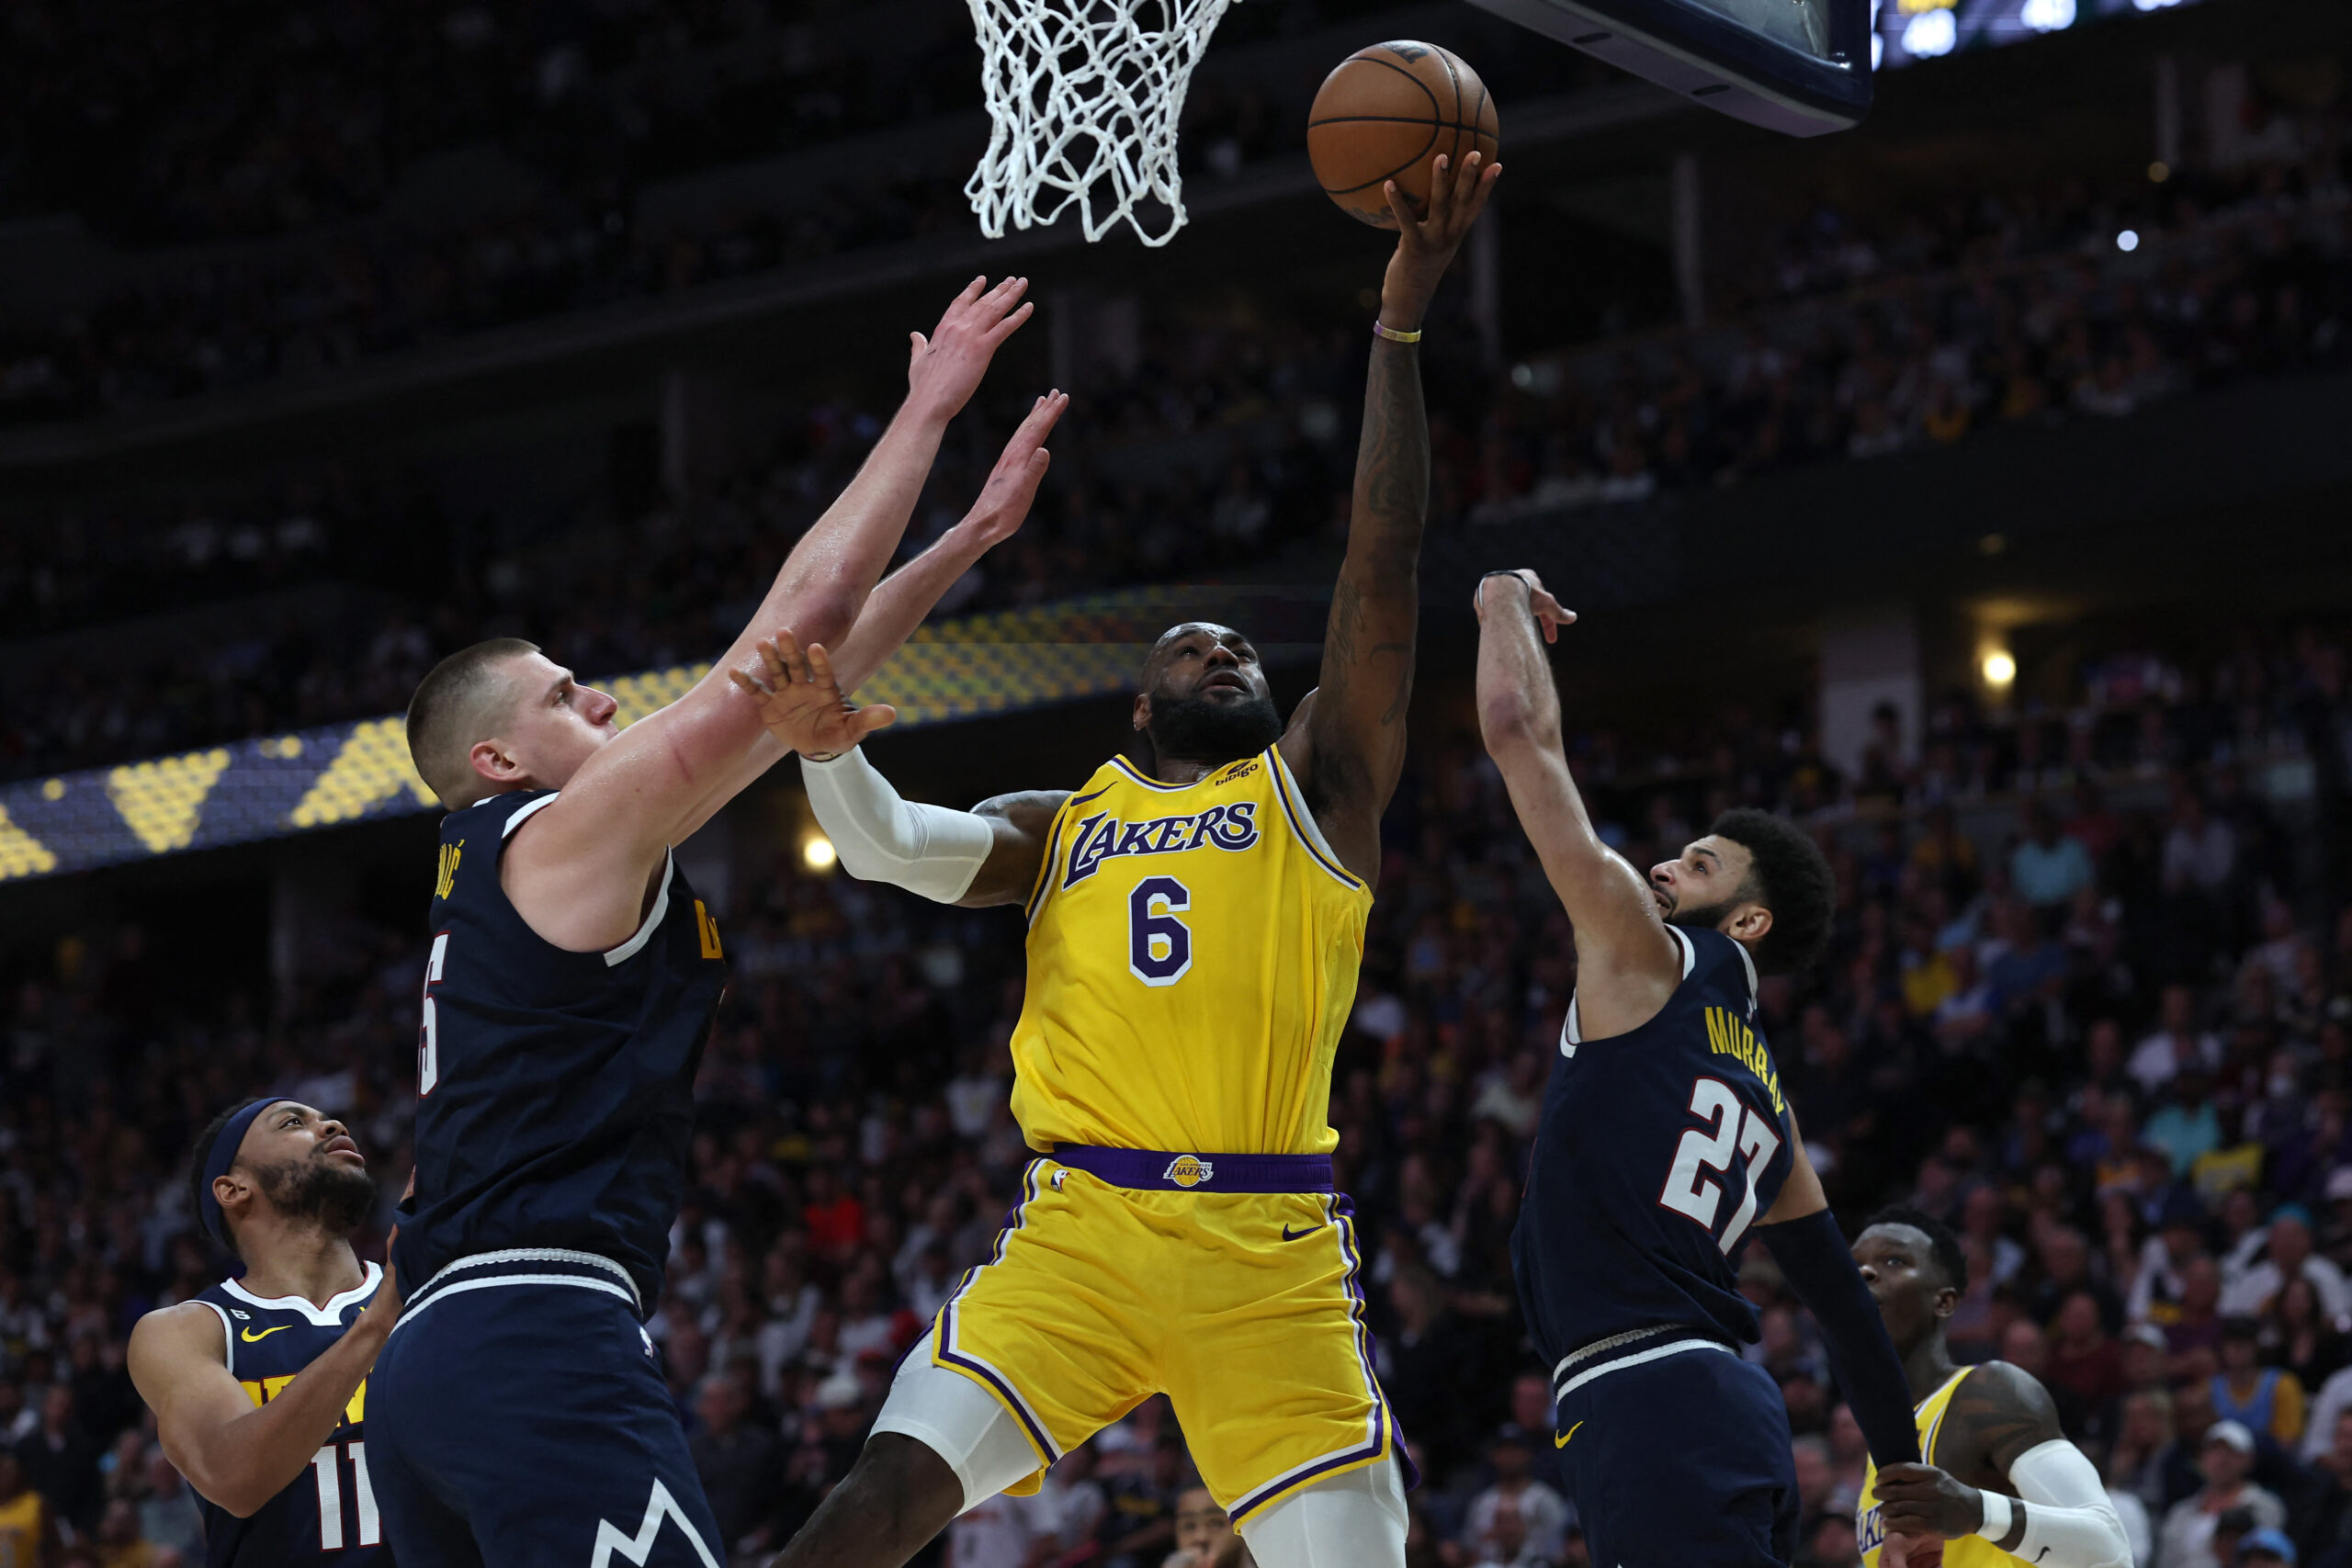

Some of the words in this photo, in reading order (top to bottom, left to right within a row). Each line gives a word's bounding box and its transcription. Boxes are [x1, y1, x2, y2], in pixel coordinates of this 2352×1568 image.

[1215, 763, 1259, 786] bibigo
[1061, 801, 1261, 893] LAKERS
[1128, 874, 1193, 988] 6
[1163, 1161, 1215, 1182] LAKERS
[1656, 1075, 1784, 1258] 27
[307, 1438, 383, 1553] 11
